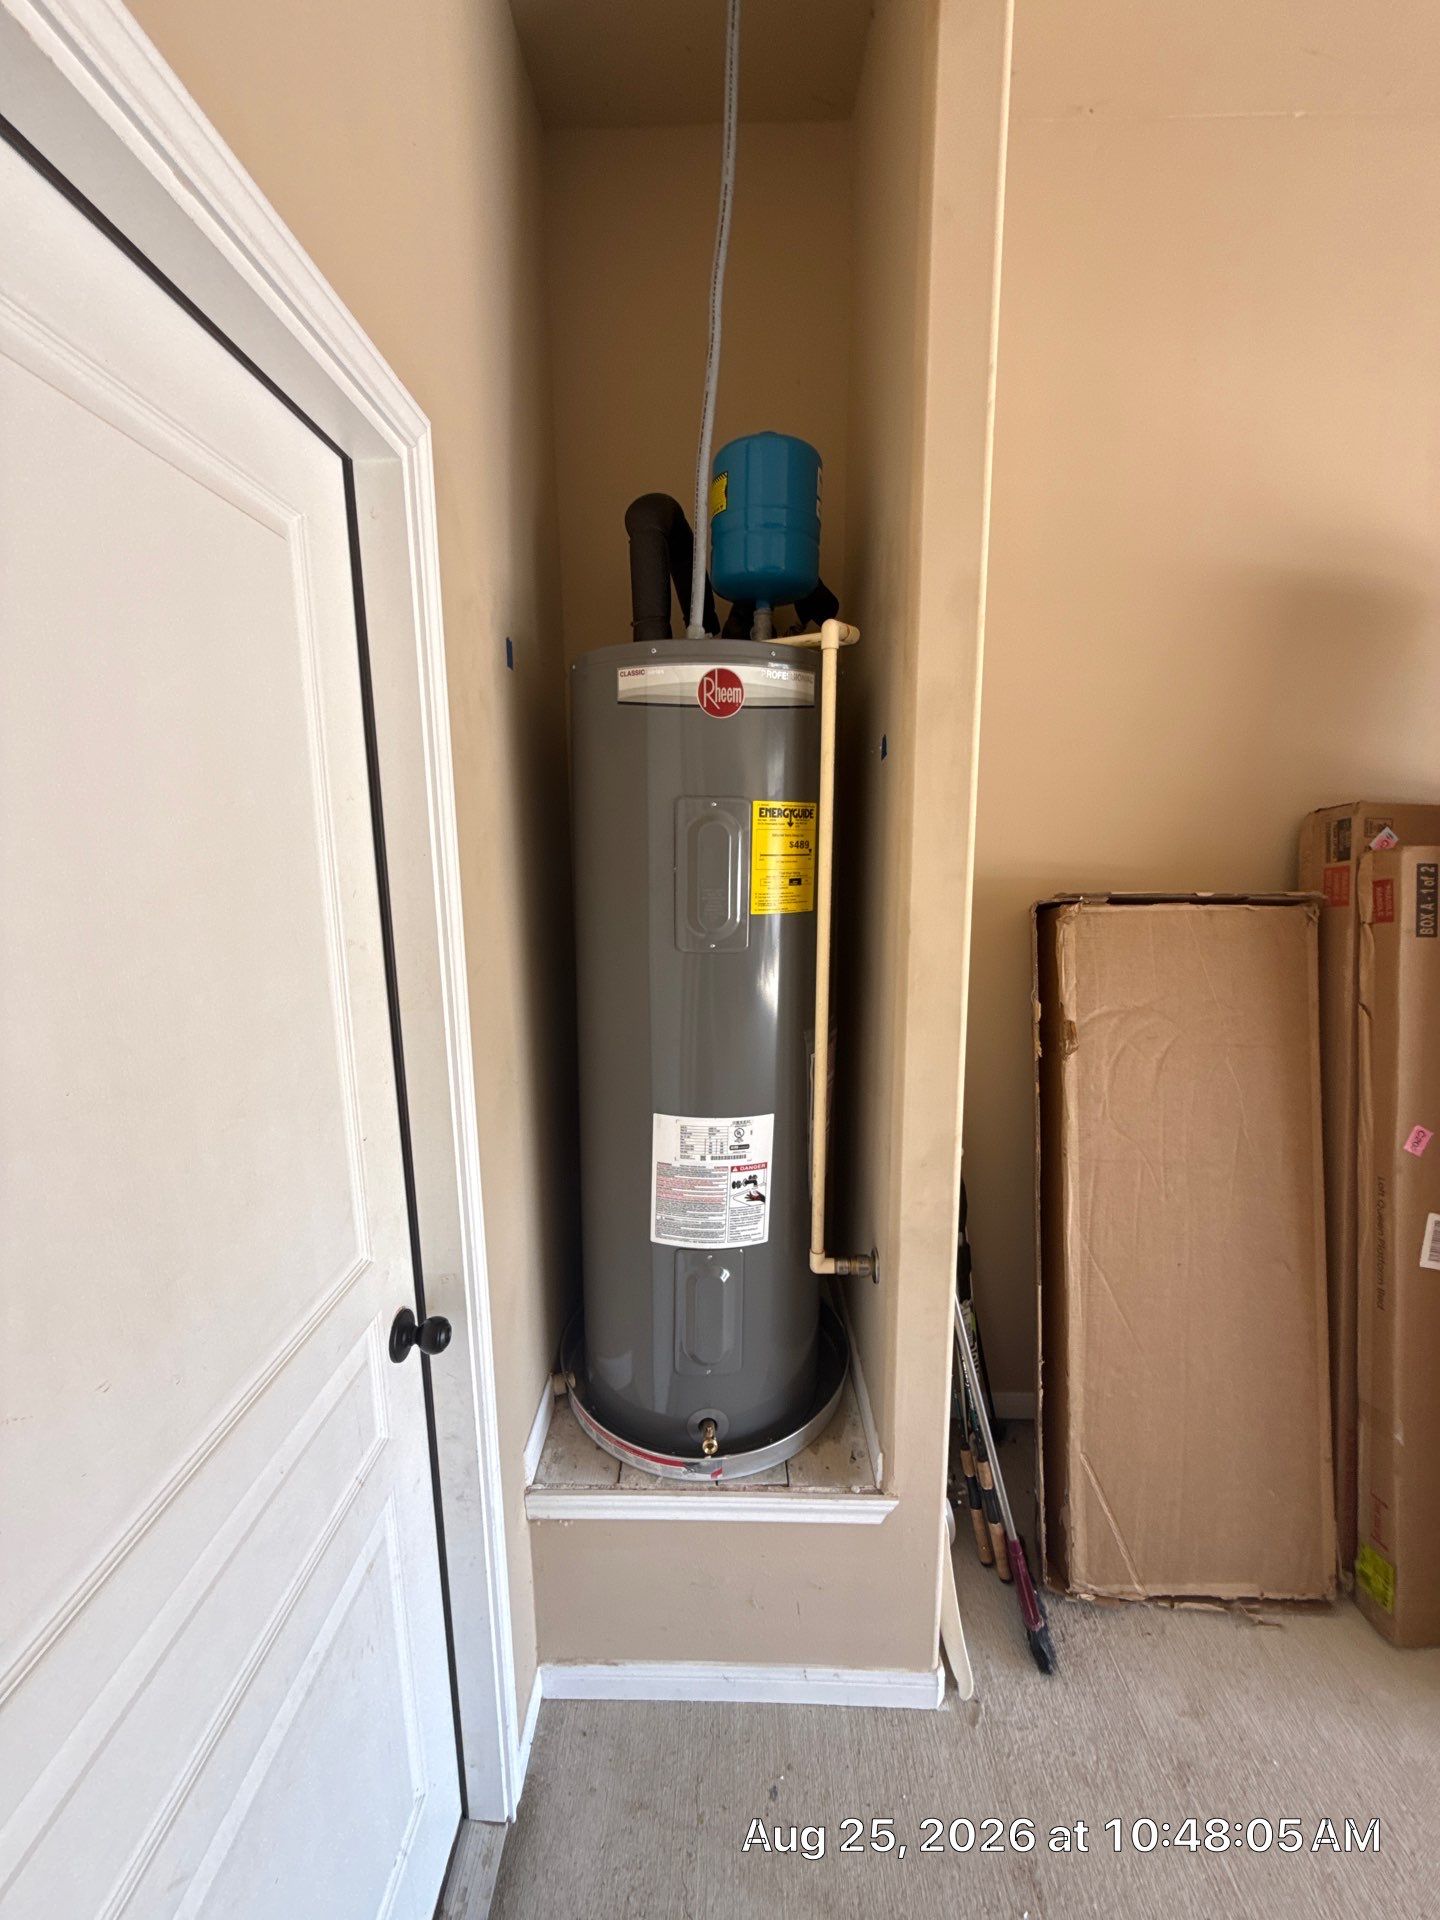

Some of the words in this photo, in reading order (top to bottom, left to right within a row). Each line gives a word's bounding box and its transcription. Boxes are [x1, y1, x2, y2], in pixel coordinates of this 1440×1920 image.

[619, 669, 646, 678] CLASSIC
[703, 669, 742, 710] Rheem
[758, 807, 814, 819] ENERGYGUIDE
[1420, 875, 1435, 887] of
[1420, 903, 1435, 911] A
[1419, 912, 1435, 935] BOX
[739, 1163, 766, 1171] DANGER
[1376, 1199, 1386, 1237] Queen
